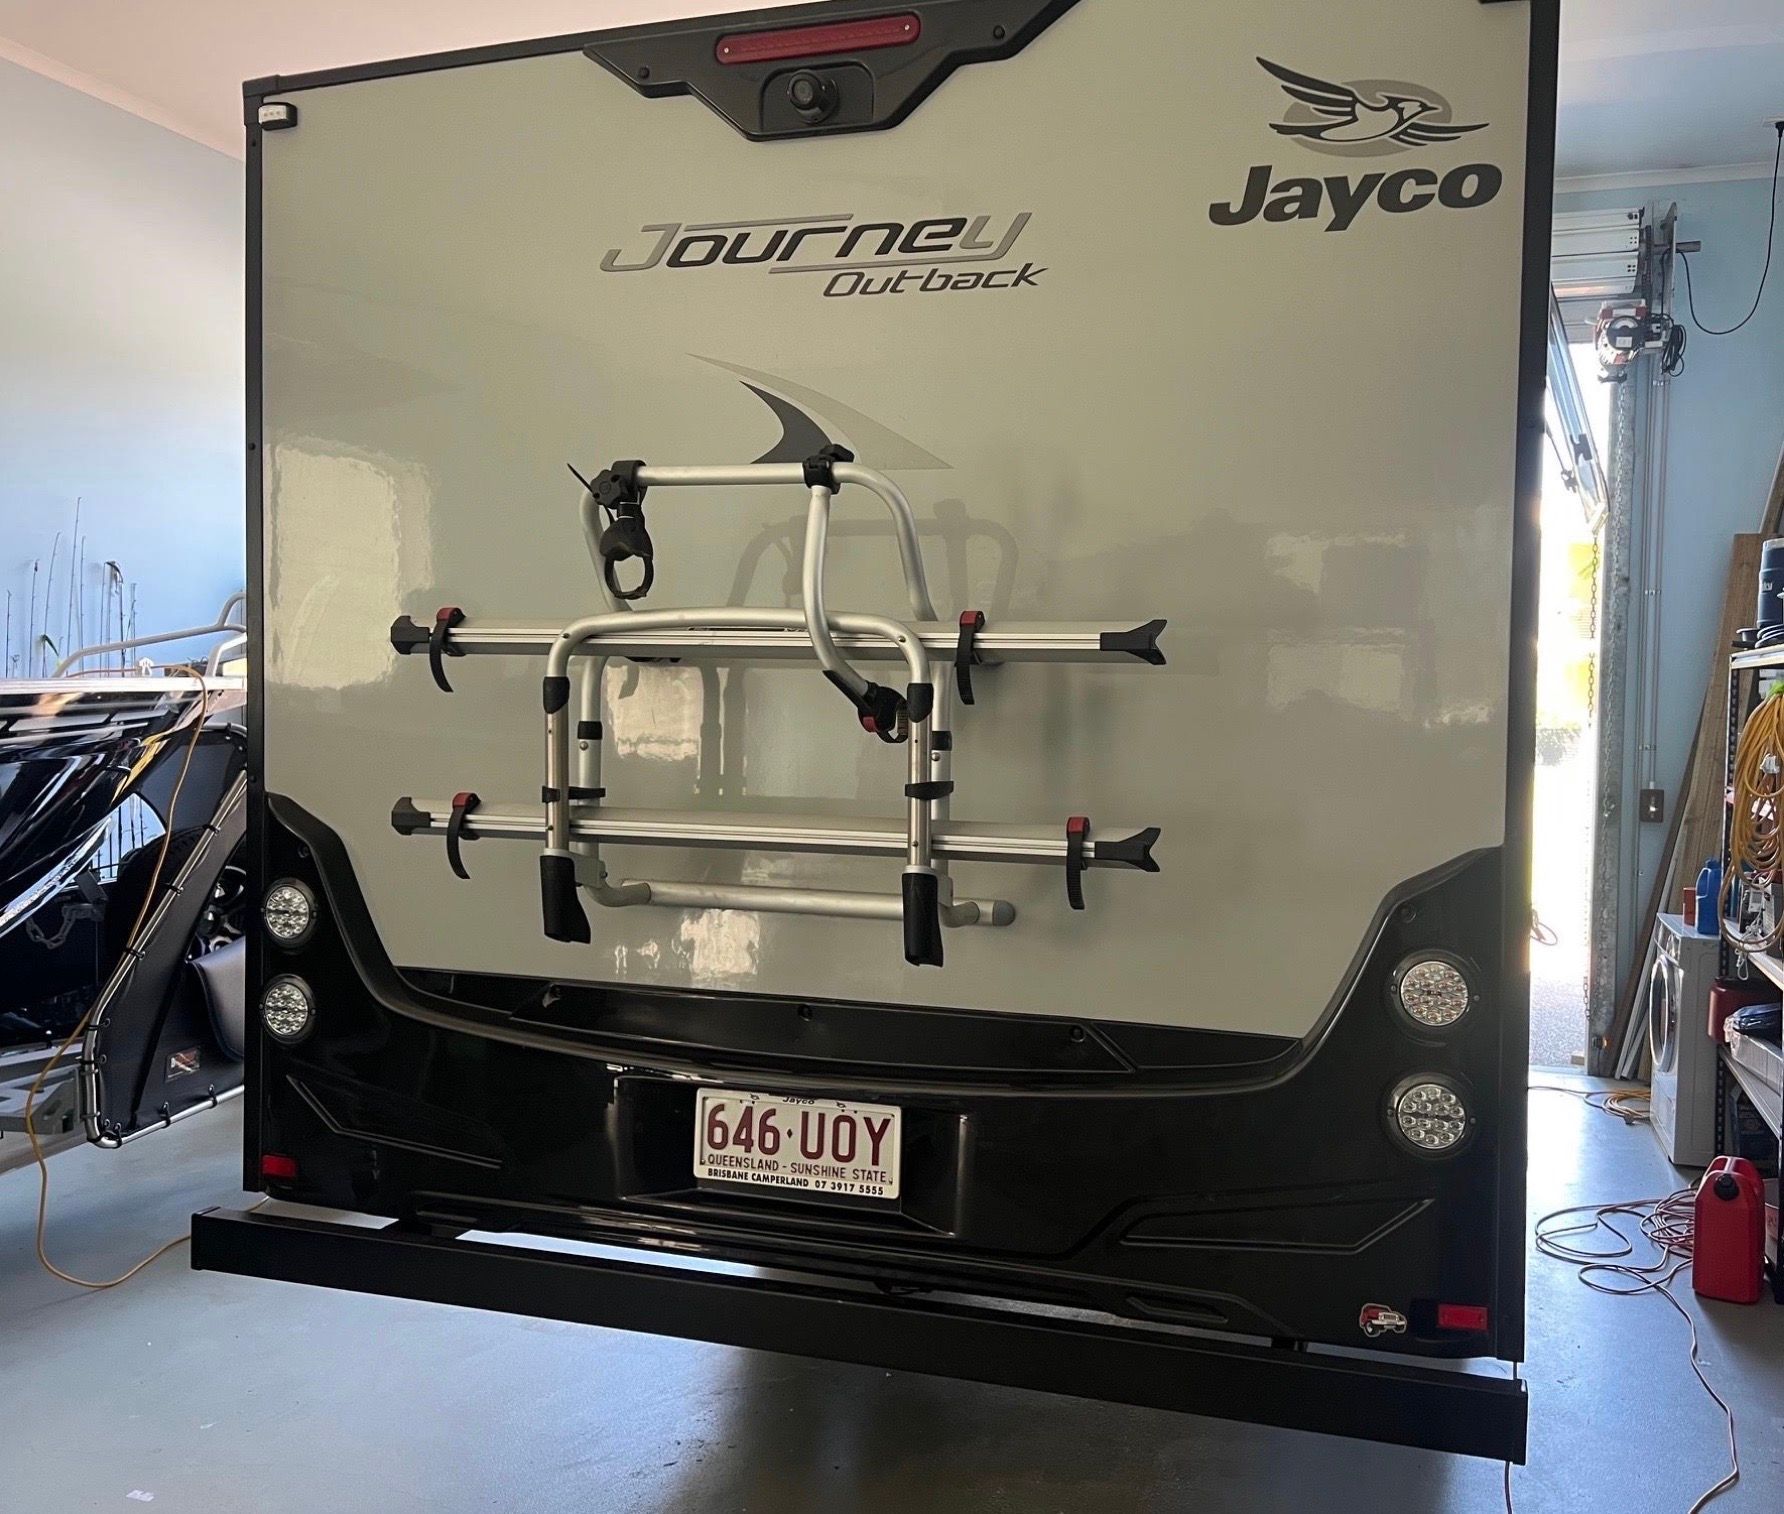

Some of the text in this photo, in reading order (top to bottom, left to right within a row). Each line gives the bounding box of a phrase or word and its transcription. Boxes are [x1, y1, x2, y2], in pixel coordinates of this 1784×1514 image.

[1208, 163, 1503, 232] Jayco
[599, 212, 1033, 272] Journey
[822, 262, 1048, 297] Outback
[707, 1103, 892, 1167] 646 UOY
[707, 1153, 779, 1171] QUEENSLAND
[790, 1162, 846, 1179] SUNSHINE
[852, 1168, 887, 1183] STATE
[708, 1168, 884, 1196] BRISBANE CAMPERLAND 07 3917 5555
